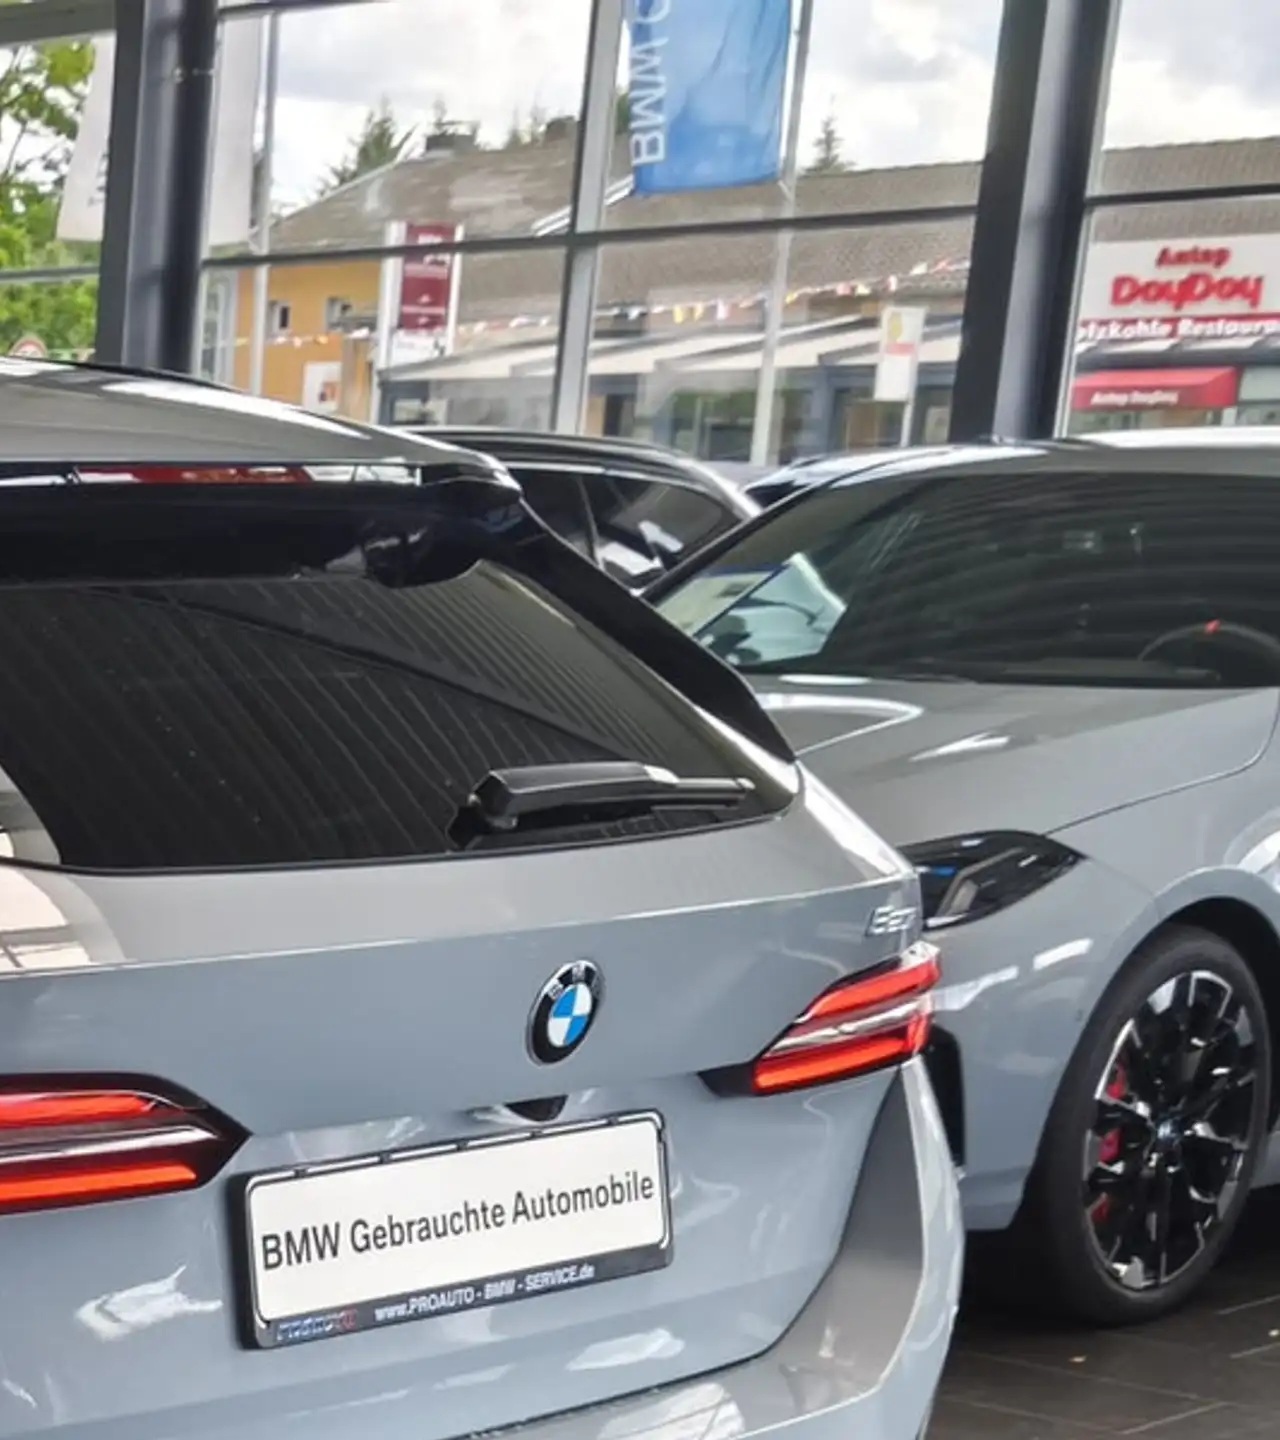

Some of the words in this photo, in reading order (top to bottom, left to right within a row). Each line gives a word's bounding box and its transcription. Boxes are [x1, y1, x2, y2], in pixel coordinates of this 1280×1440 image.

[628, 33, 671, 167] BMW
[1156, 246, 1231, 267] Antep
[261, 1221, 341, 1271] BMW
[349, 1201, 506, 1254] Gebrauchte
[512, 1171, 655, 1222] Automobile
